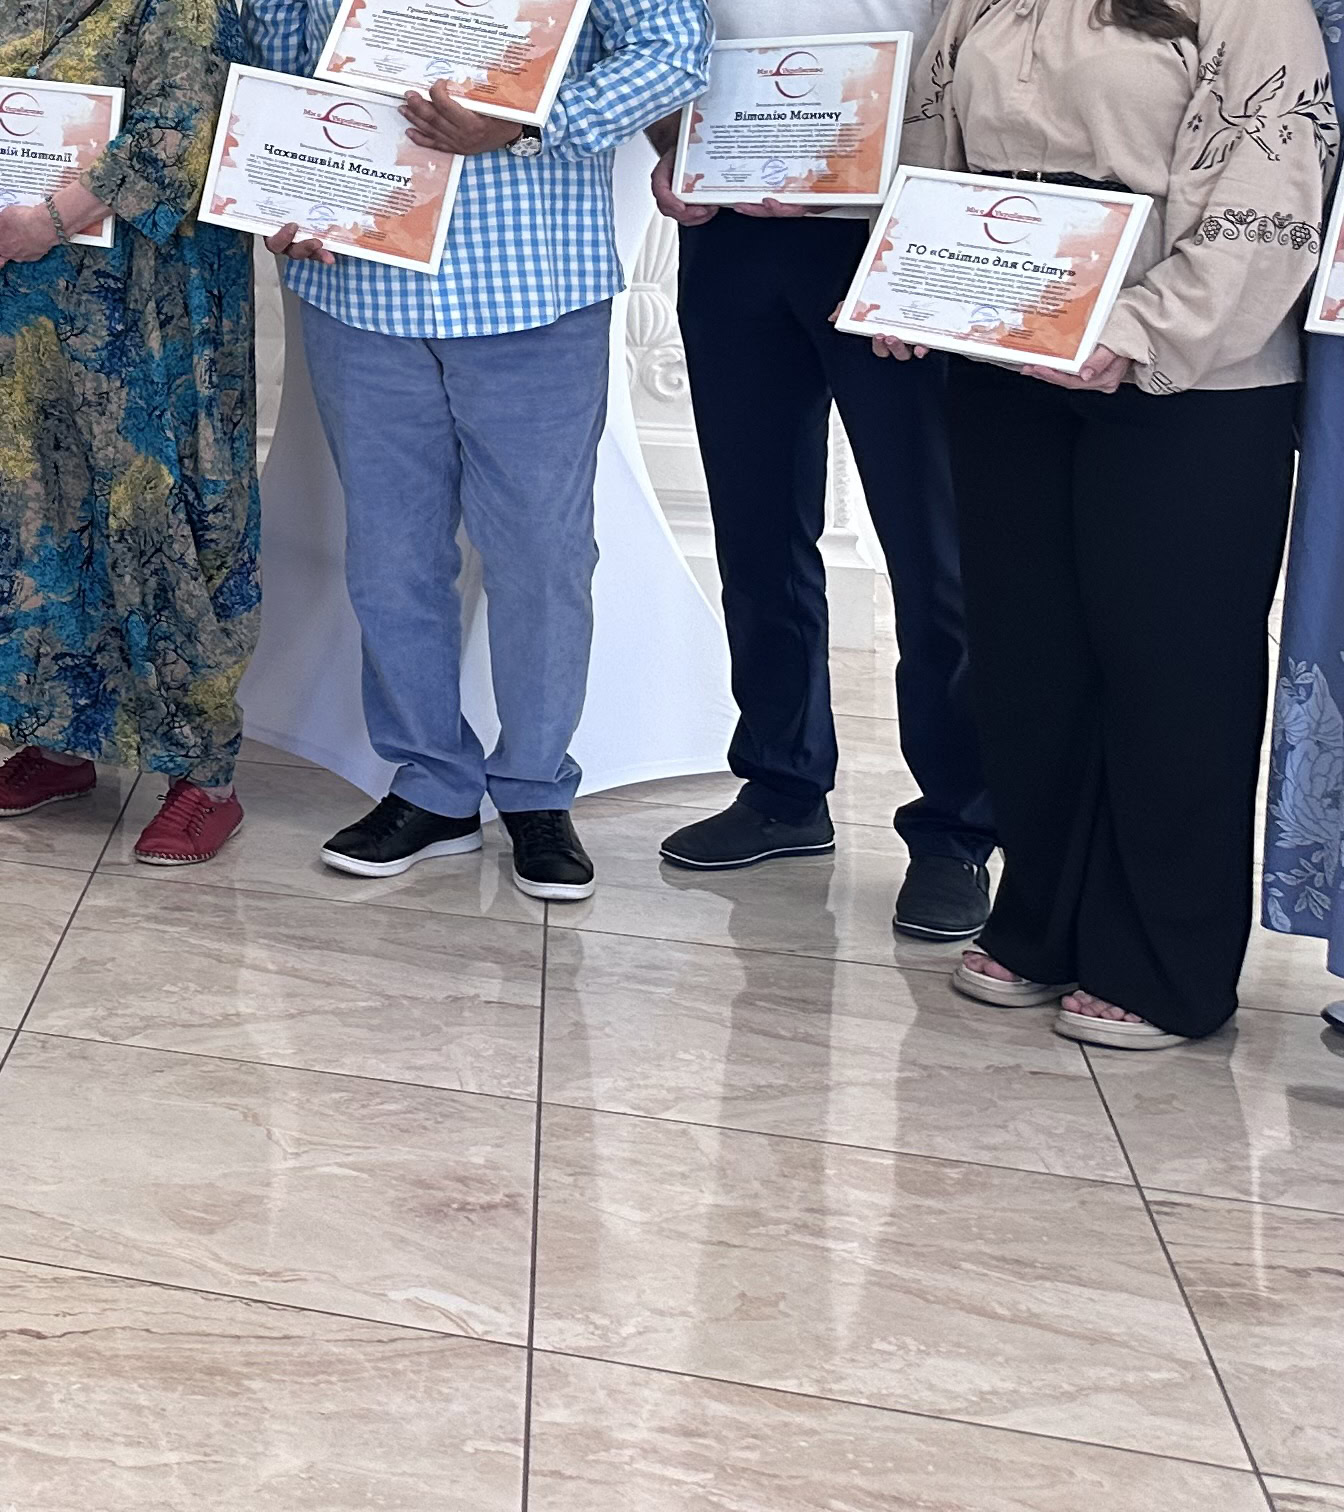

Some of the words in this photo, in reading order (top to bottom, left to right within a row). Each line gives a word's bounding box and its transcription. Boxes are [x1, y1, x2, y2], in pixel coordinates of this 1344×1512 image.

[734, 110, 787, 121] Віталію
[789, 110, 842, 122] Маничу
[20, 148, 73, 163] Наталії
[264, 143, 345, 171] Чахвашвілі
[348, 162, 412, 187] Малхазу
[906, 243, 927, 255] ГО
[929, 248, 989, 266] «Світло
[992, 256, 1019, 270] для
[1021, 261, 1077, 279] Світу»
